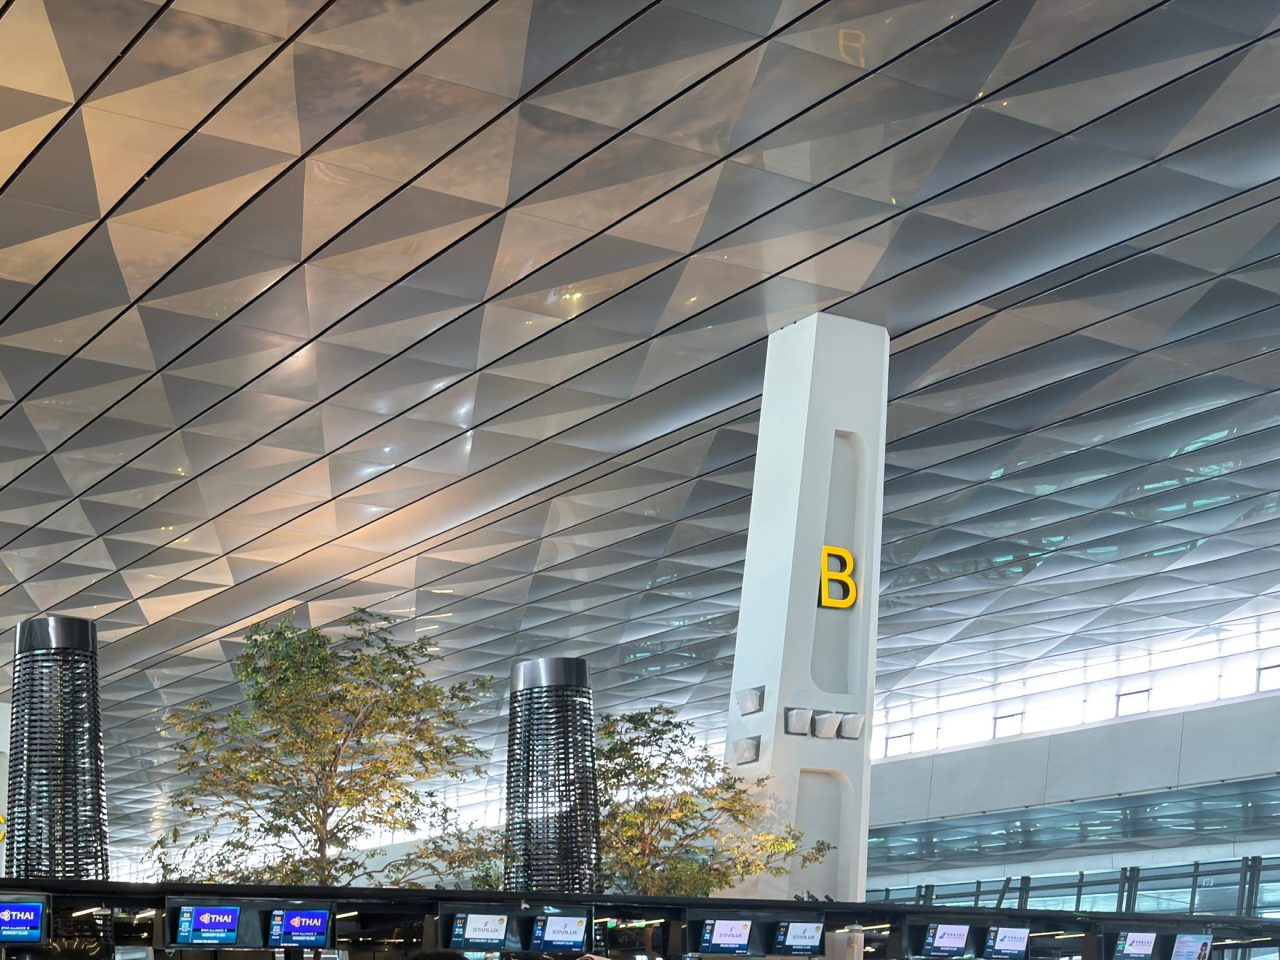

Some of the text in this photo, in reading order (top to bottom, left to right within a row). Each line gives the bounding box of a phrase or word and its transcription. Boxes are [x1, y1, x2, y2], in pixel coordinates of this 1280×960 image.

[819, 545, 857, 608] B
[11, 911, 34, 920] THAI
[211, 914, 232, 923] THAI
[301, 918, 322, 926] THAI
